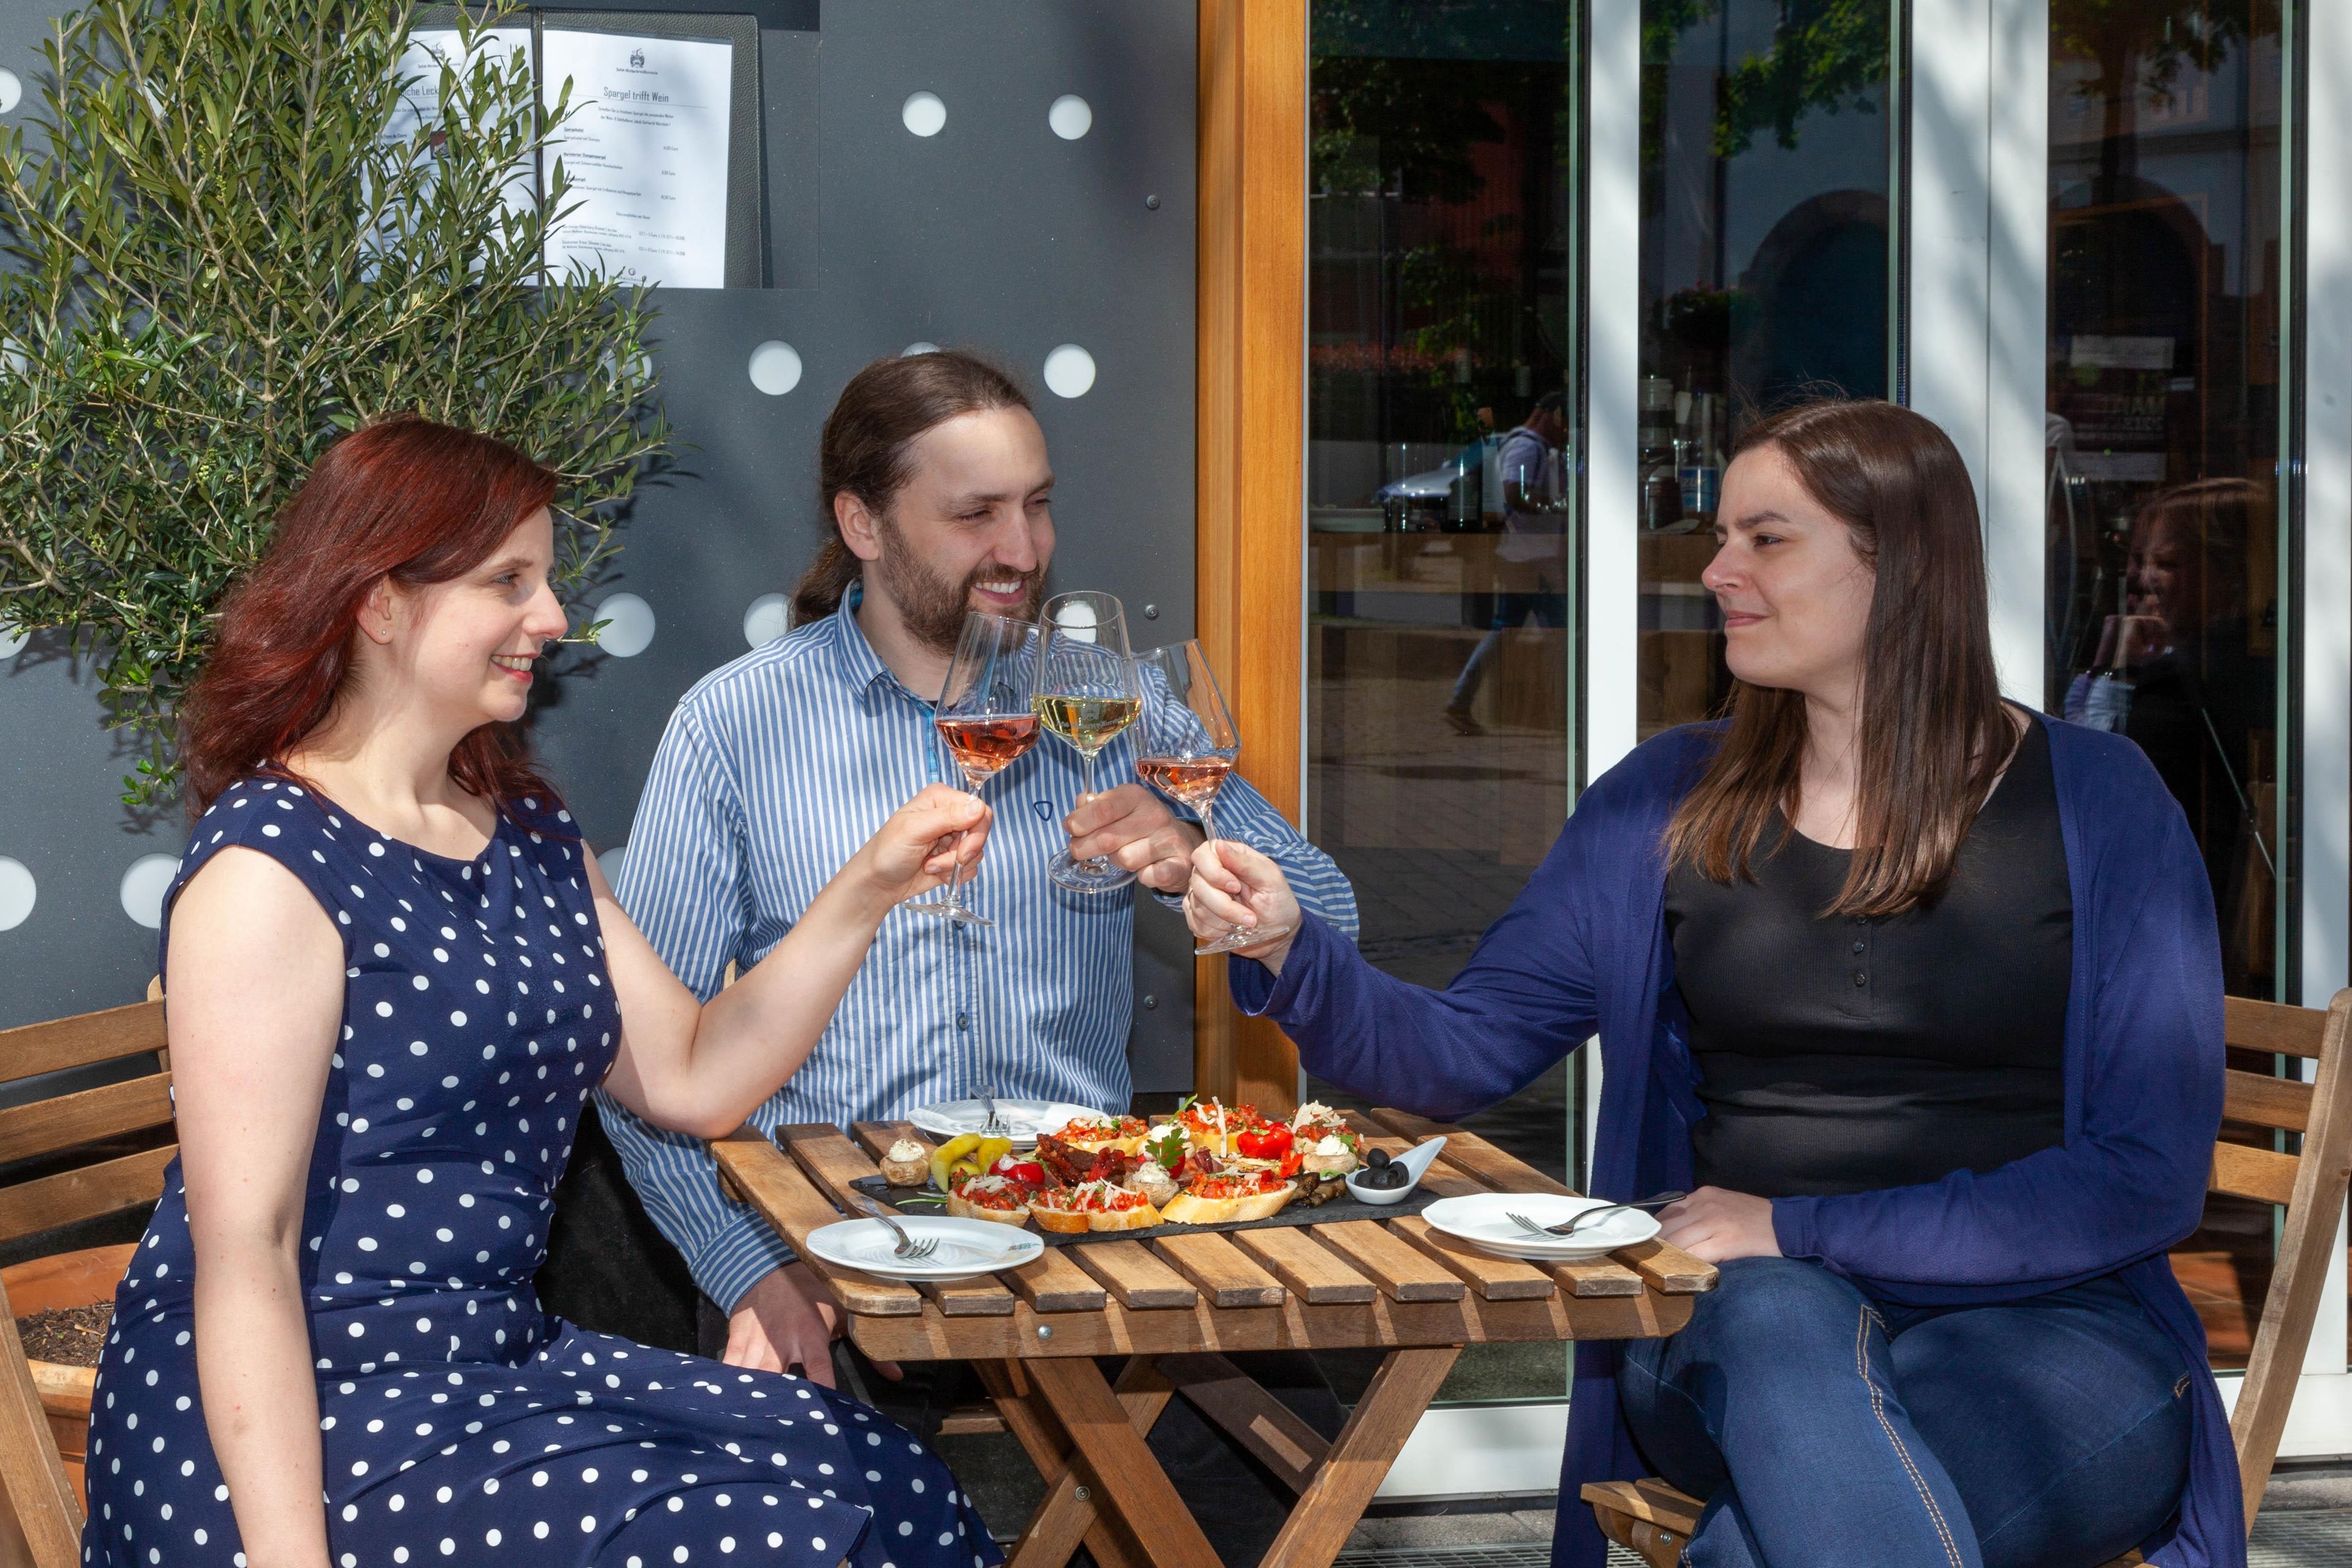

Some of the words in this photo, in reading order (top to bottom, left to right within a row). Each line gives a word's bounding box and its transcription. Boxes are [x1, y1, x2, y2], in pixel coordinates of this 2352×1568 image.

[603, 86, 631, 100] Spargel
[633, 91, 650, 101] trifft
[652, 91, 669, 102] Wein
